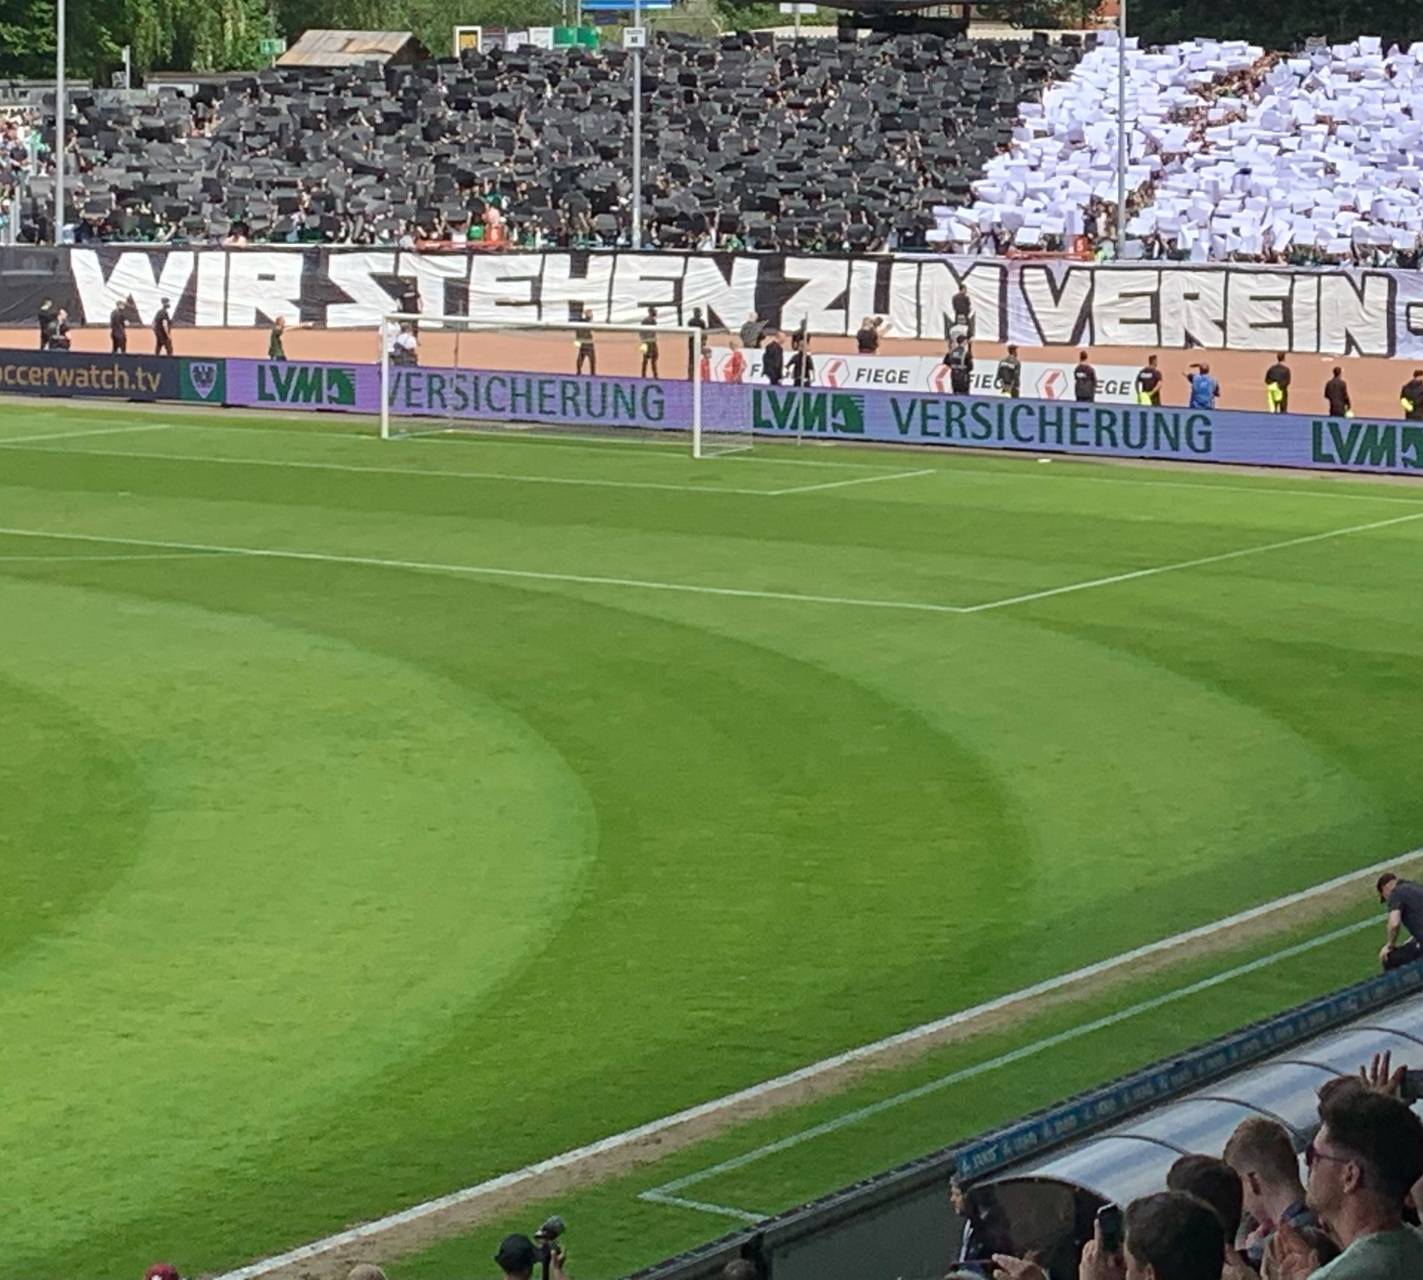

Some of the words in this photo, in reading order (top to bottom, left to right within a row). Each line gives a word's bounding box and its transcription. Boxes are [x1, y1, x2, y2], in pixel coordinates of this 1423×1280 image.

[70, 248, 304, 327] WIR
[327, 251, 757, 335] STEHEN
[780, 256, 1008, 343] ZUM
[1020, 264, 1396, 357] VEREIN
[257, 365, 323, 402] LVM
[378, 370, 665, 421] VERSICHERUNG
[855, 367, 911, 385] FIEGE
[752, 389, 827, 433] LVM
[889, 397, 1213, 454] VERSICHERUNG
[1311, 421, 1397, 468] LVM
